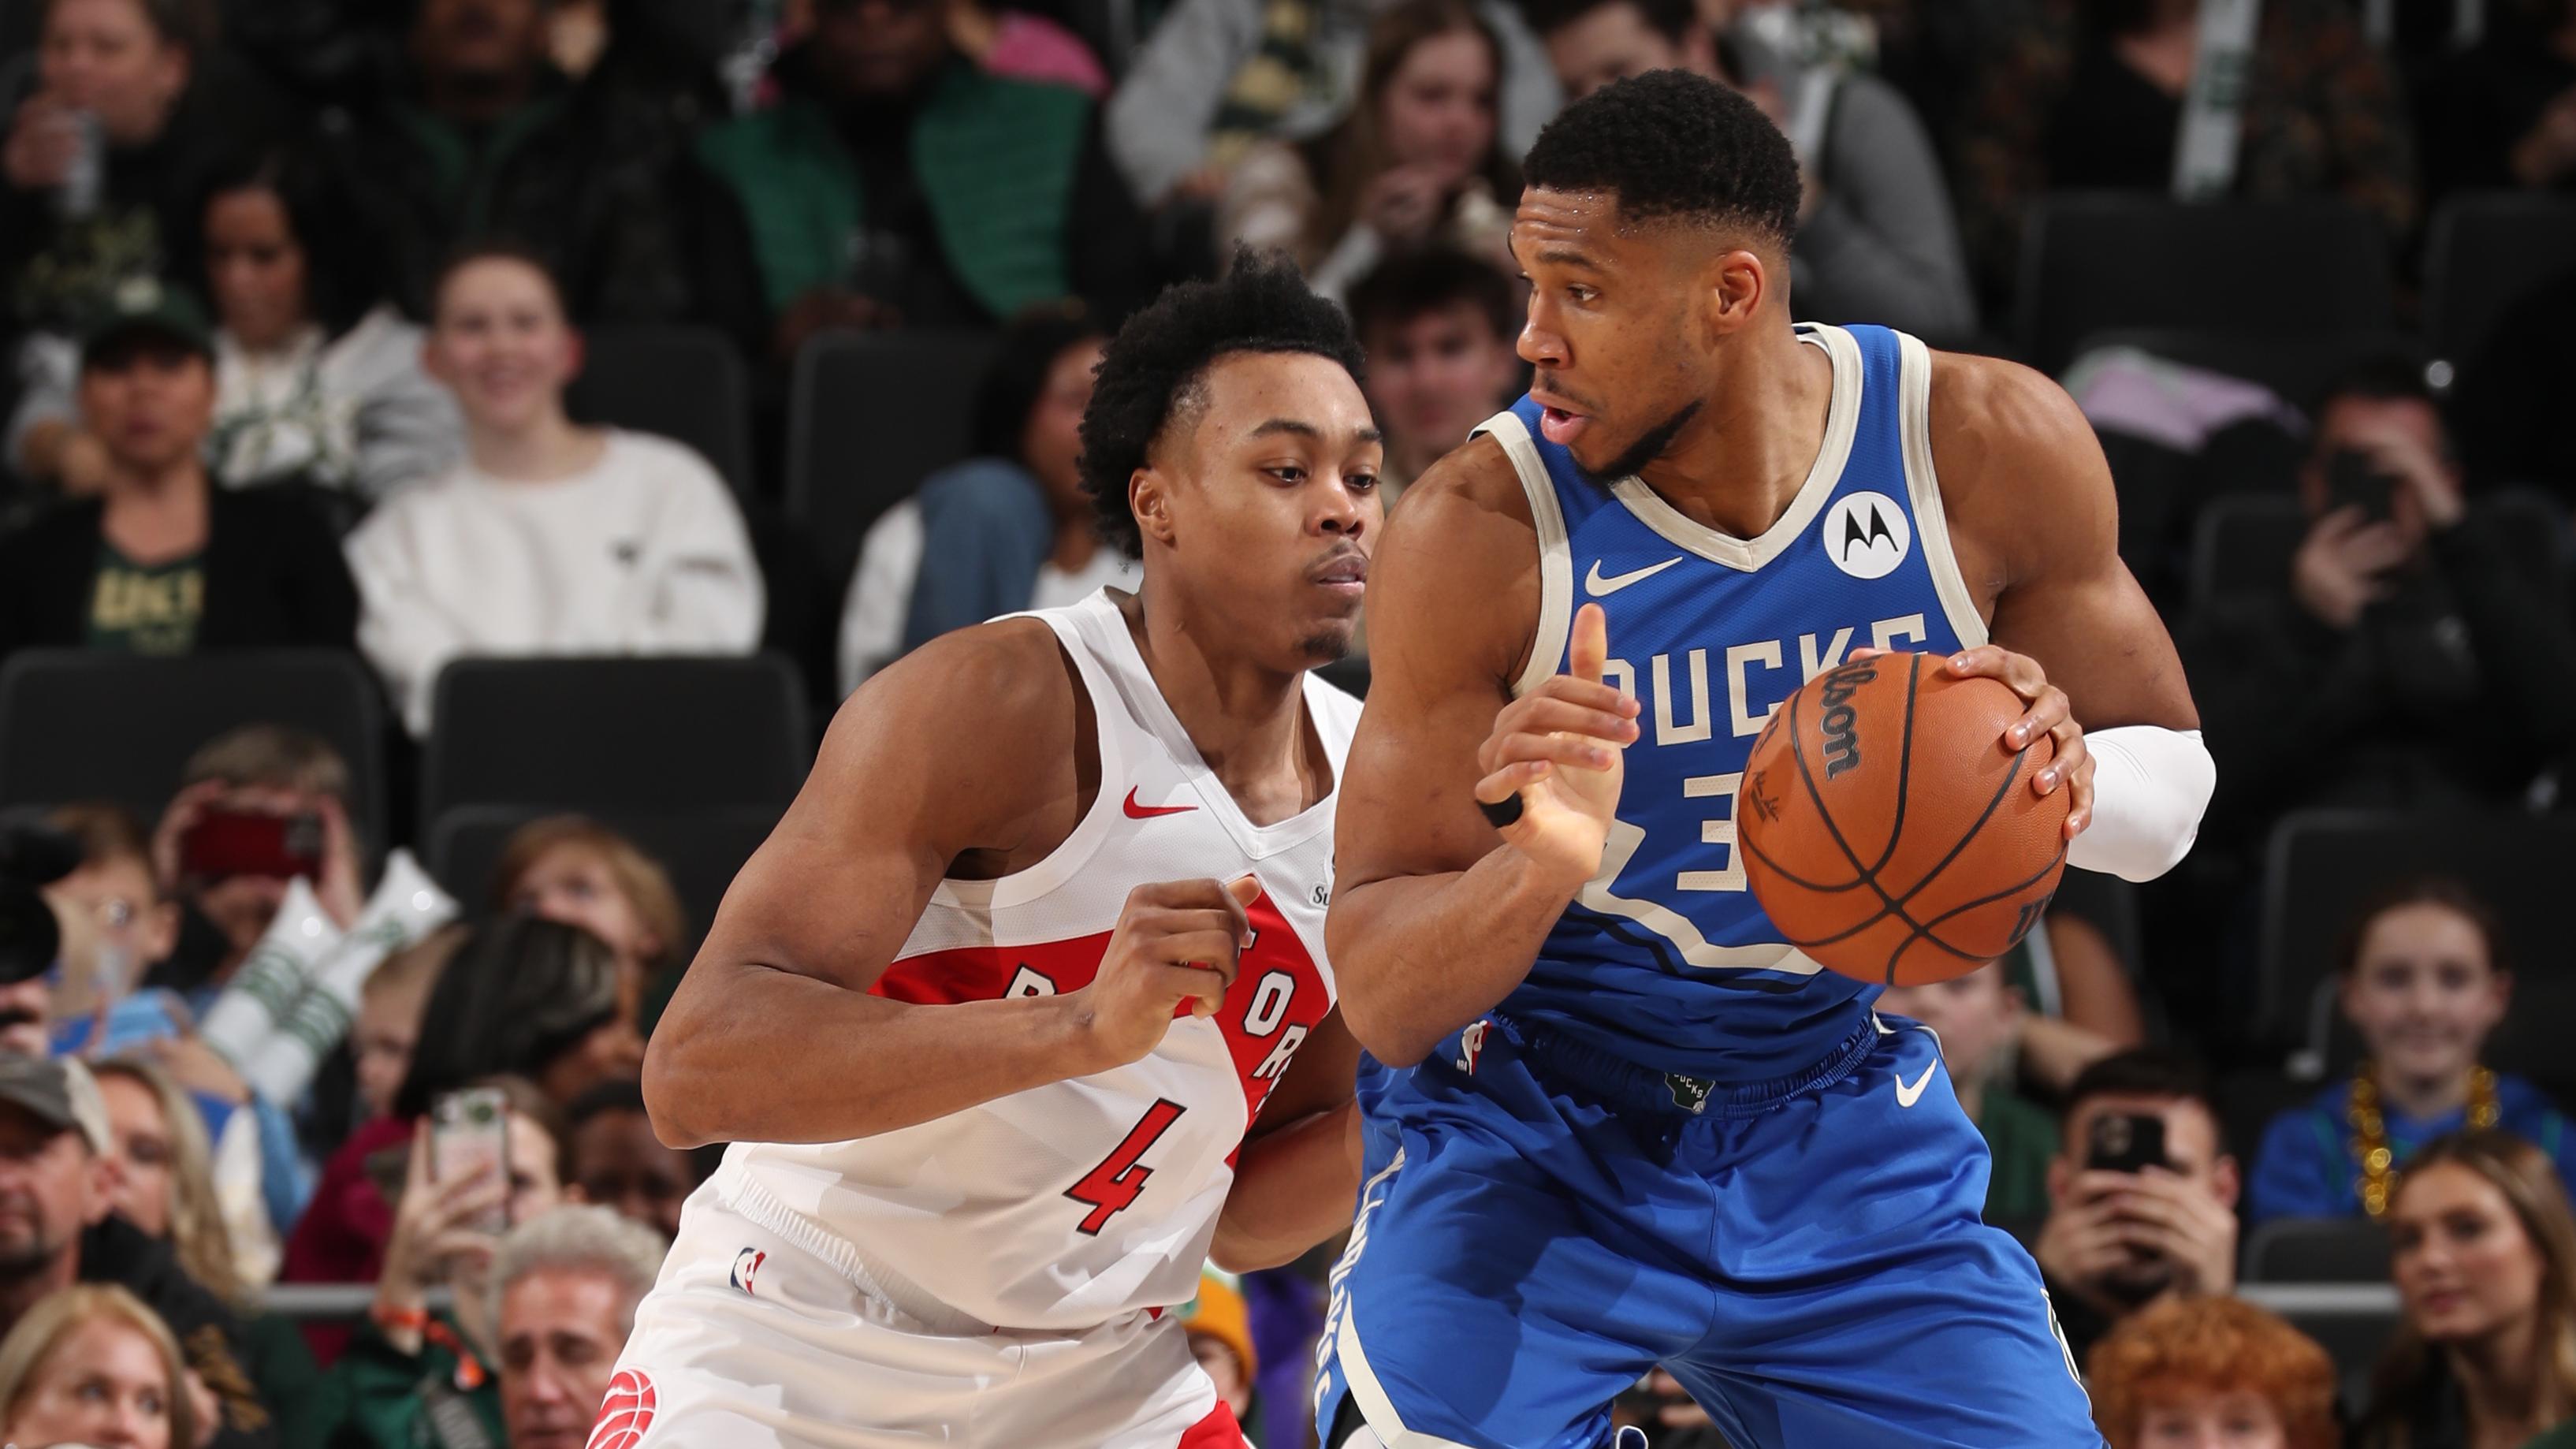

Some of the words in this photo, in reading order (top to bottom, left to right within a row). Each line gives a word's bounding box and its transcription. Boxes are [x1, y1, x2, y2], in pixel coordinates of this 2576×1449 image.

[1312, 885, 1330, 906] Su
[1673, 1073, 1703, 1098] UCKS
[1063, 1097, 1188, 1237] 4
